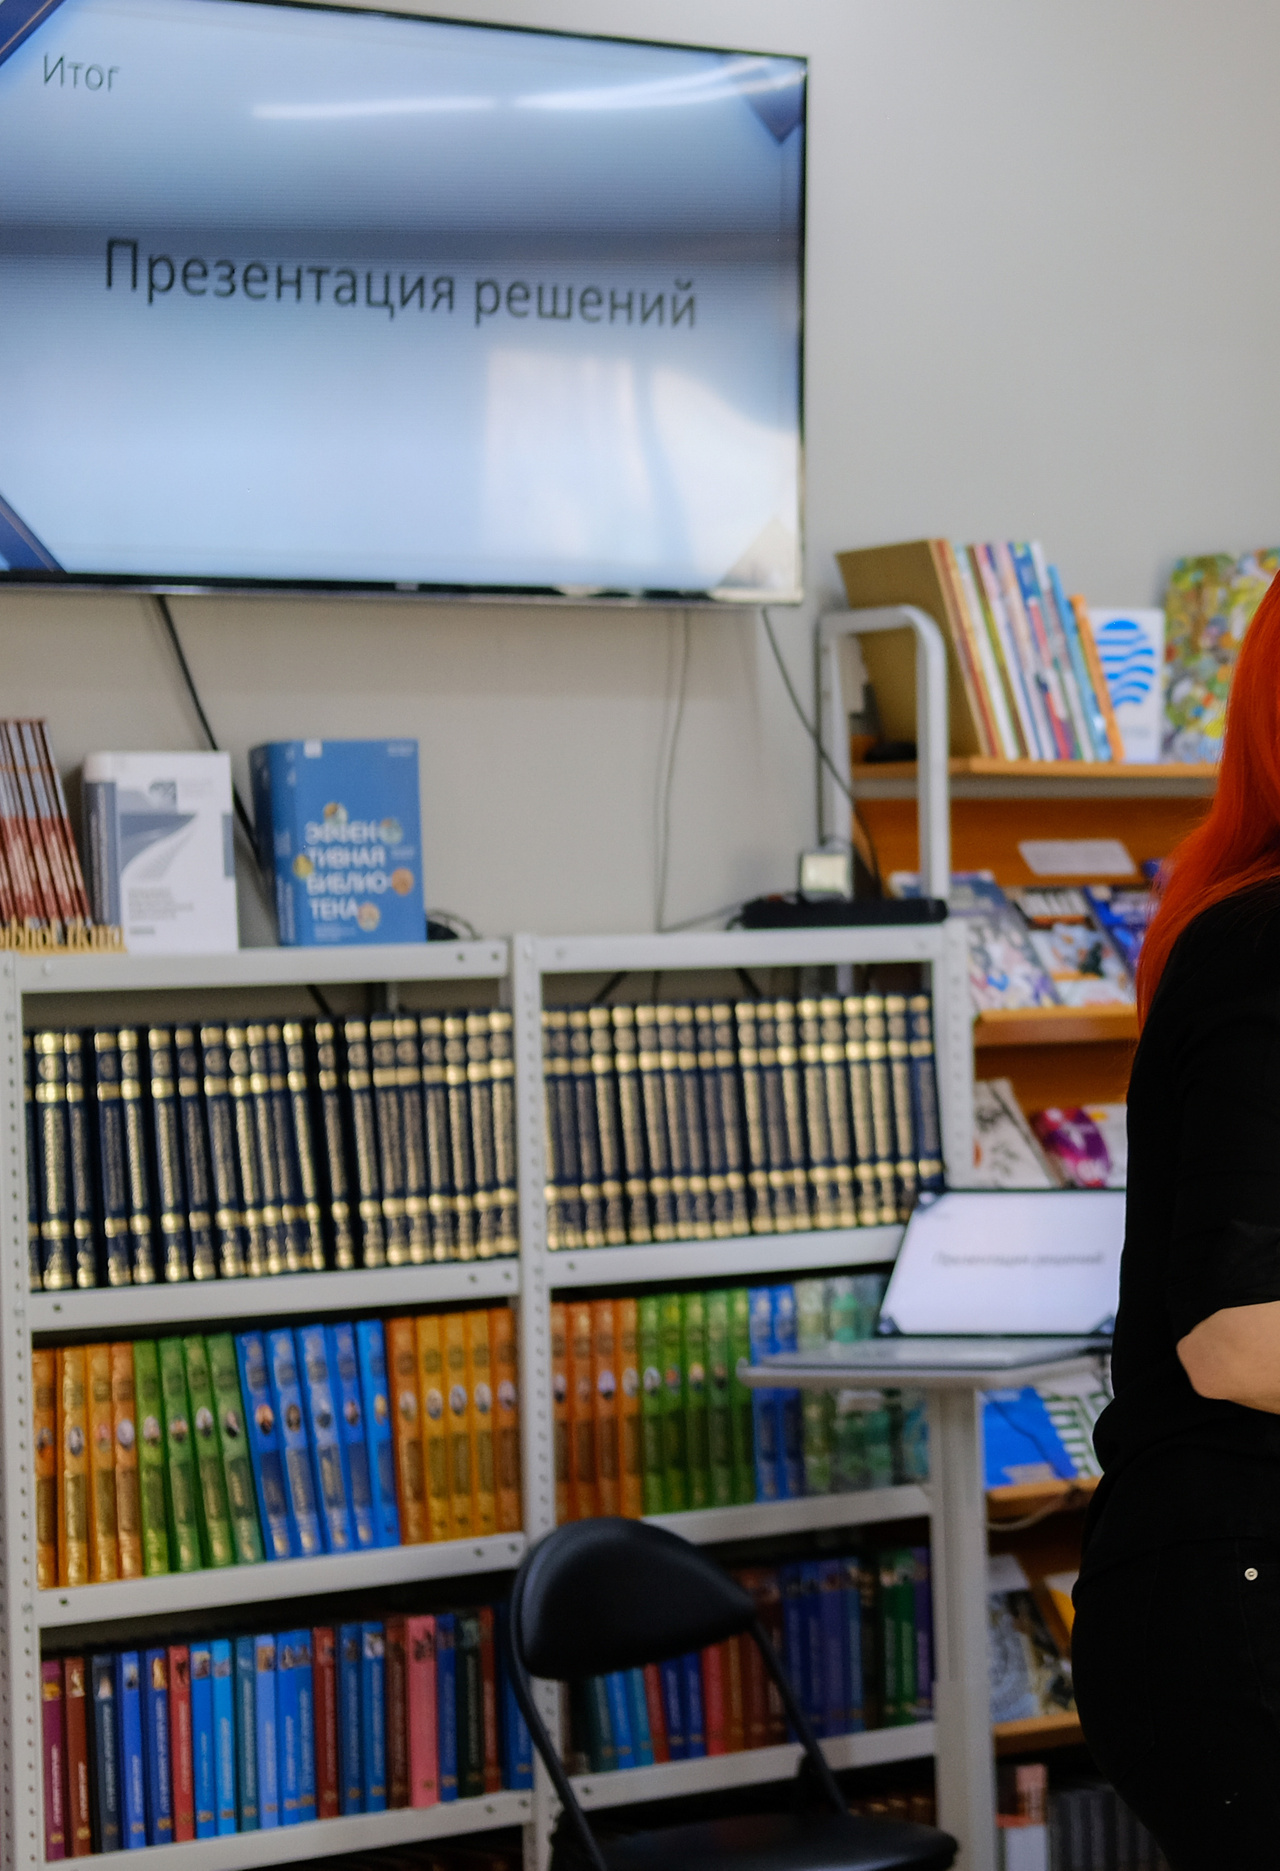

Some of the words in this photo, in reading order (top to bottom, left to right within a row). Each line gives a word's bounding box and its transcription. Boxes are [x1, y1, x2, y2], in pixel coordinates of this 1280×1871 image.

[43, 53, 120, 92] Итог
[106, 237, 454, 321] Презентация
[473, 277, 695, 329] решений
